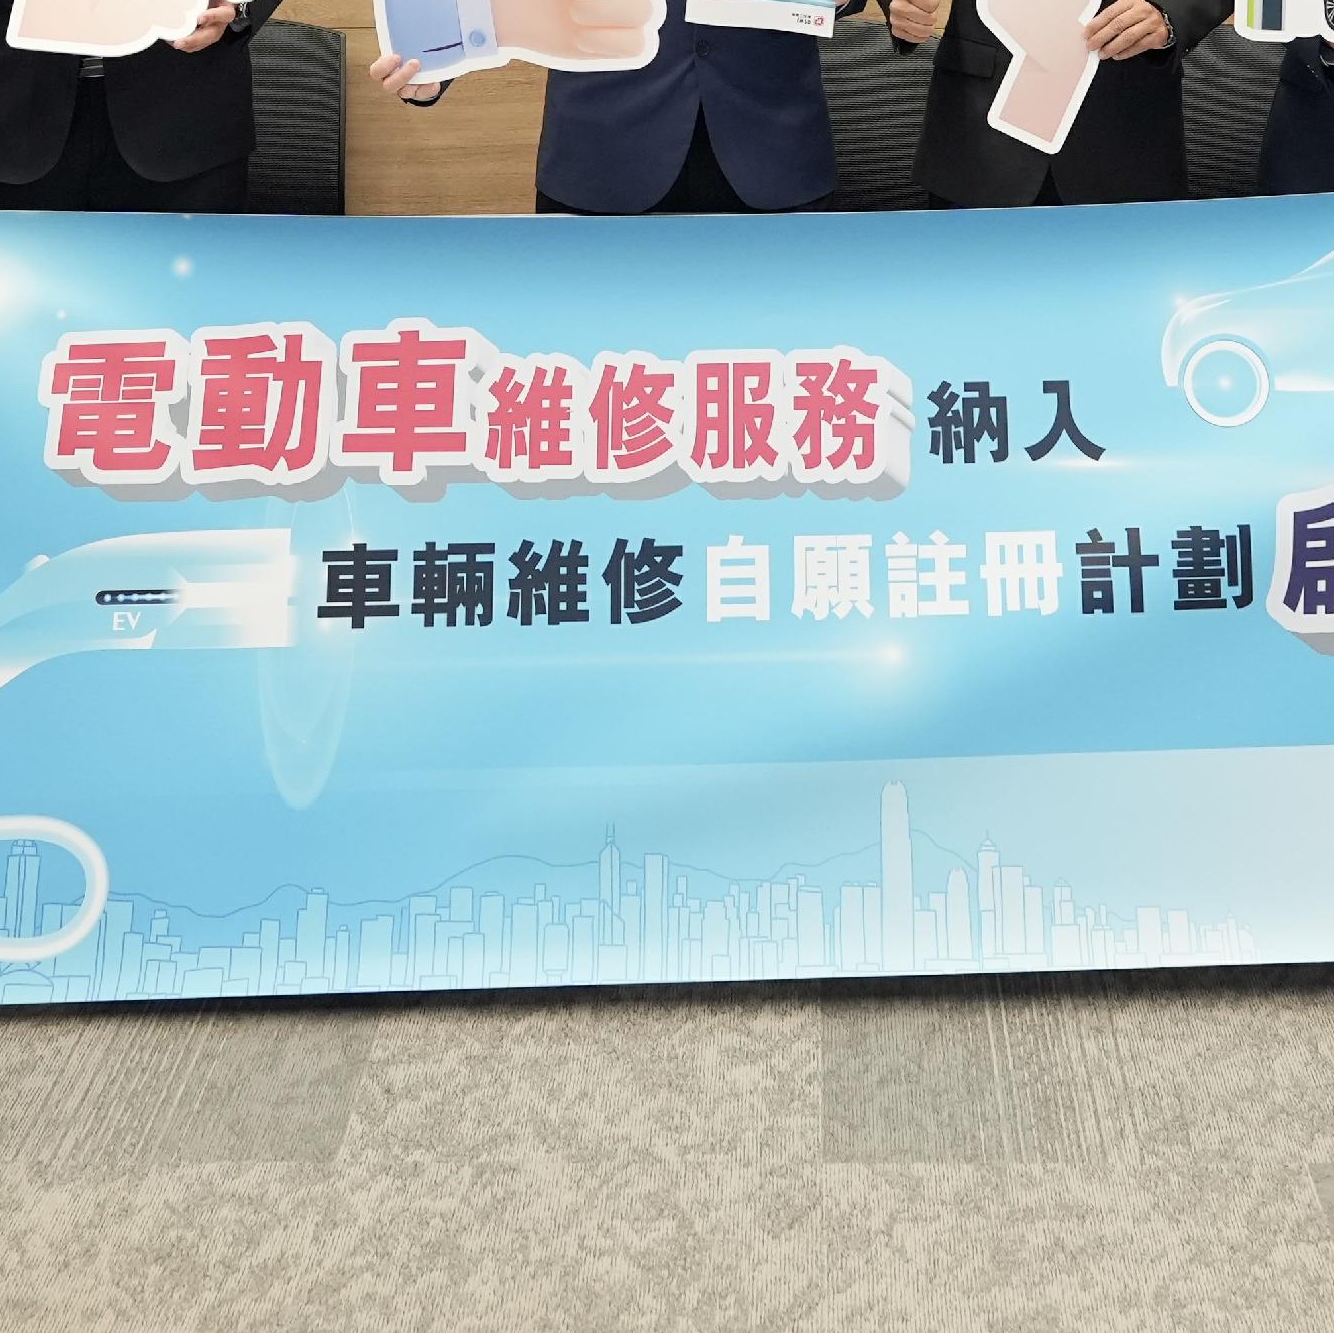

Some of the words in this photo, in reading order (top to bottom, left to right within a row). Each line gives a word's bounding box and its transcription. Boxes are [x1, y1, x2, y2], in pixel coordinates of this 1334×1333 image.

[50, 328, 881, 474] 電動車維修服務
[927, 379, 1107, 466] 納入
[112, 611, 142, 632] EV
[316, 521, 1255, 631] 車輛維修自願註冊計劃
